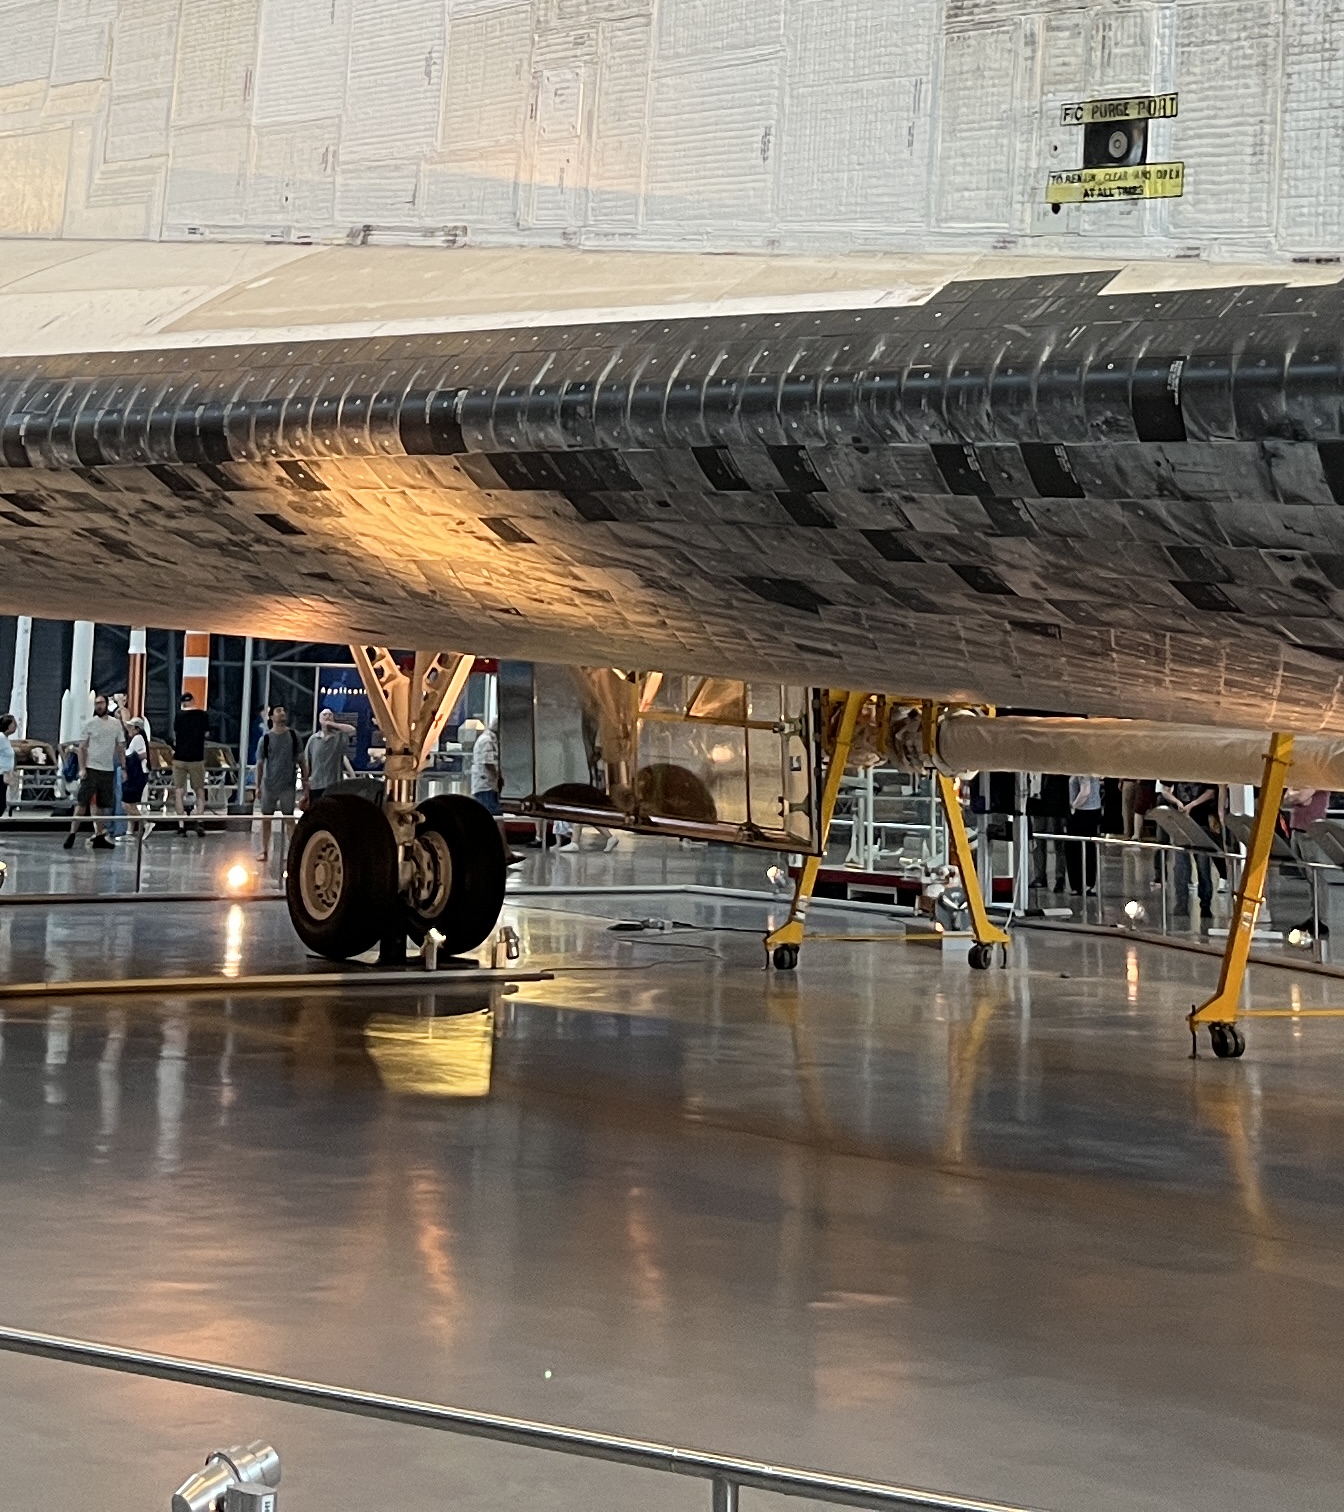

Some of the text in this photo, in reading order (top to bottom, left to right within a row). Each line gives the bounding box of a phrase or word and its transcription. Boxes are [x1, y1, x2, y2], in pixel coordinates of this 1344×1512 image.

[1091, 101, 1130, 119] PURGE
[1137, 97, 1176, 116] PORT
[1156, 168, 1179, 180] OPEN
